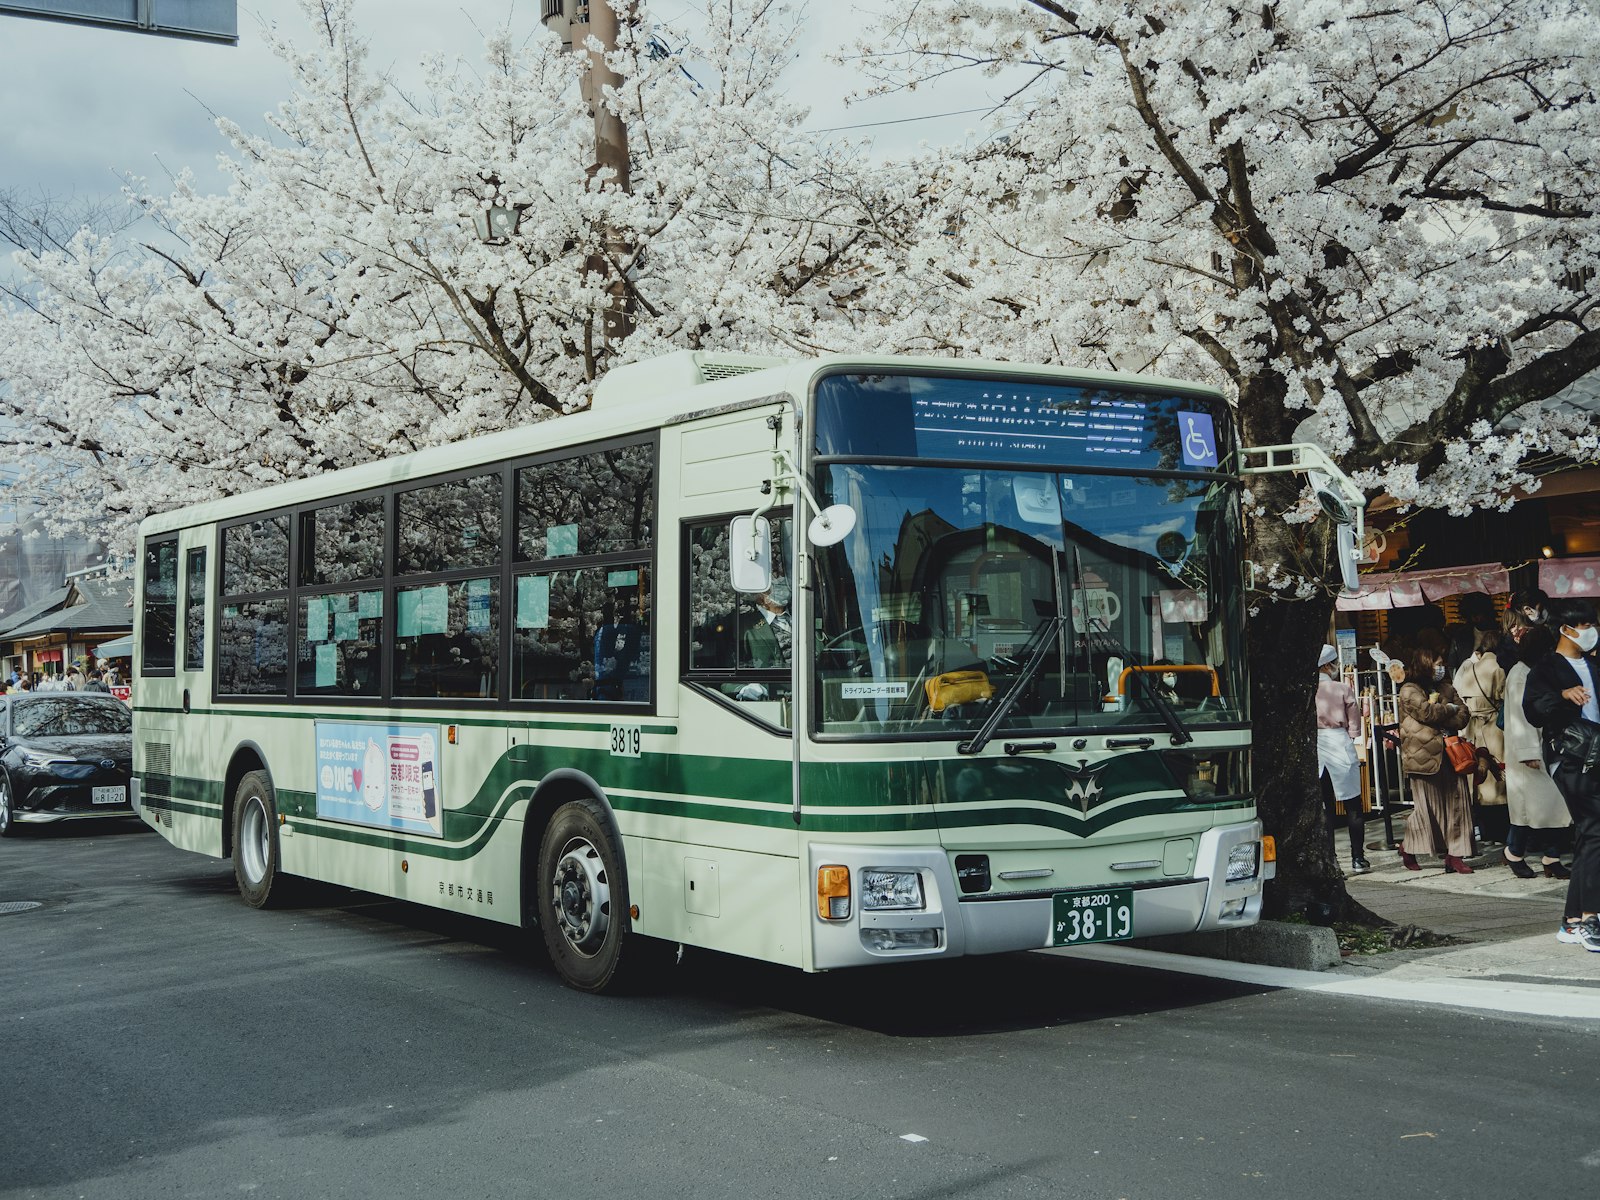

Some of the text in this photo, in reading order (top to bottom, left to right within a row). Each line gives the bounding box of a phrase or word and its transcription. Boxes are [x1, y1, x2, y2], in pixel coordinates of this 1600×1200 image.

[1074, 638, 1121, 648] RAHIYAMA
[611, 727, 640, 754] 3819
[390, 762, 420, 783] 京都限定
[100, 793, 125, 802] 81-20
[438, 881, 494, 906] 京都市交通局
[1072, 894, 1111, 908] 京都200
[1056, 905, 1131, 941] か 38-19
